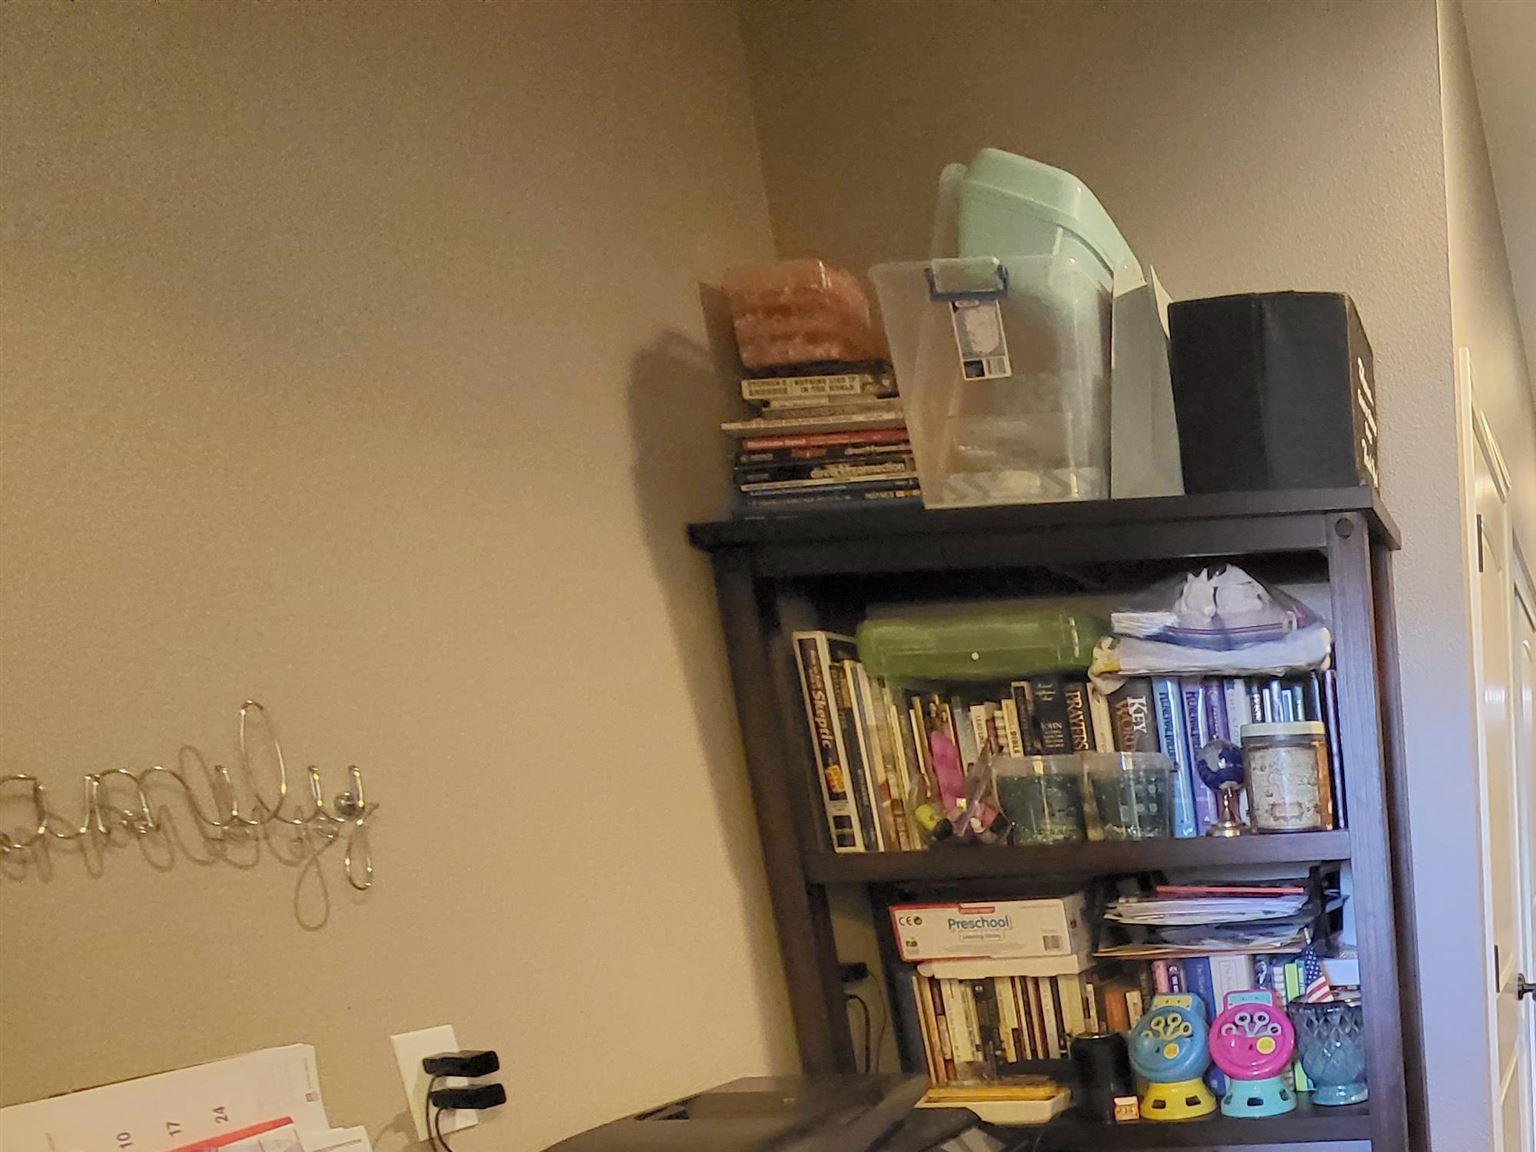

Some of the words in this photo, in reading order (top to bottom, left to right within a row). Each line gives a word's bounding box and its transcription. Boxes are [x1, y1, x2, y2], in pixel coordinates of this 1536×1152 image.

[811, 690, 834, 750] Skeptic
[1065, 689, 1089, 751] PRAYERS
[1127, 696, 1147, 734] KEY
[947, 915, 1010, 930] Preschool
[212, 1105, 229, 1124] 24
[166, 1121, 183, 1138] 17
[116, 1131, 134, 1150] 10
